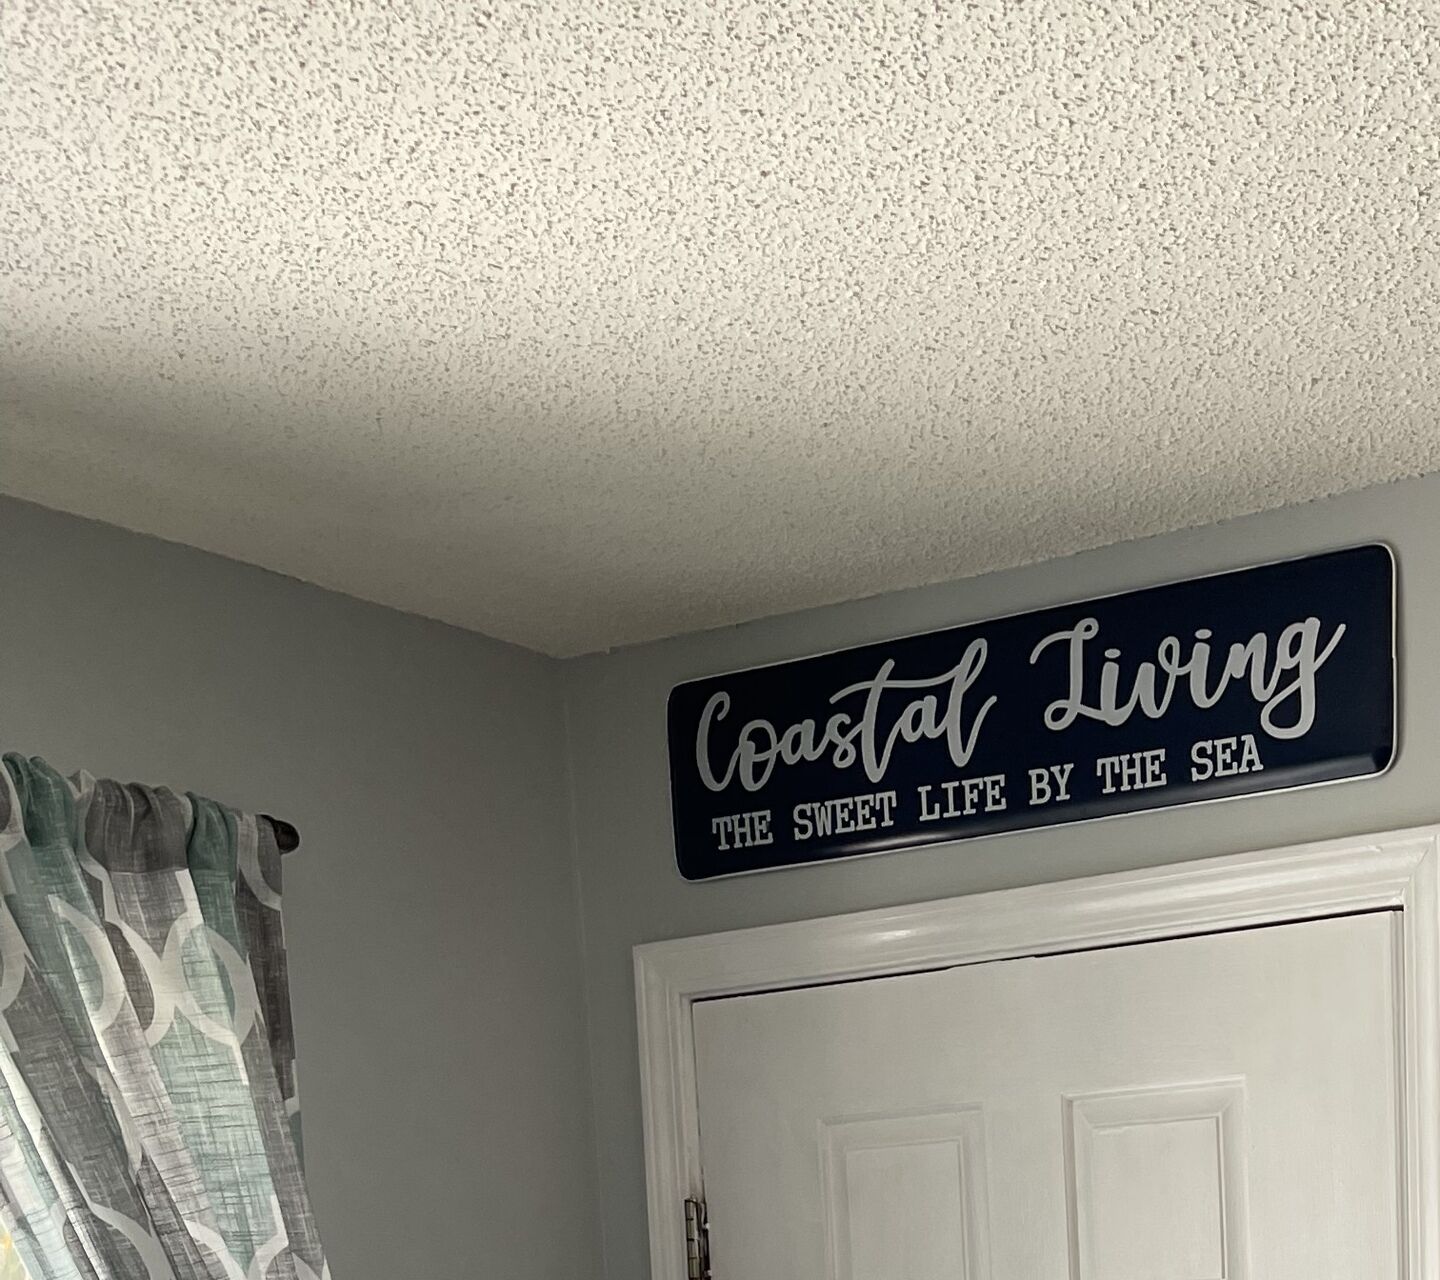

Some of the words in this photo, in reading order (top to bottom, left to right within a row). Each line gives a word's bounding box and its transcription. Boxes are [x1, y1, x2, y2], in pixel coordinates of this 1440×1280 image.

[697, 638, 997, 791] Coastal
[1030, 617, 1346, 739] Living
[712, 810, 773, 850] THE
[794, 791, 897, 840] SWEET
[918, 774, 1006, 821] LIFE
[1029, 763, 1074, 805] BY
[1097, 749, 1167, 793] THE
[1191, 734, 1263, 781] SEA
